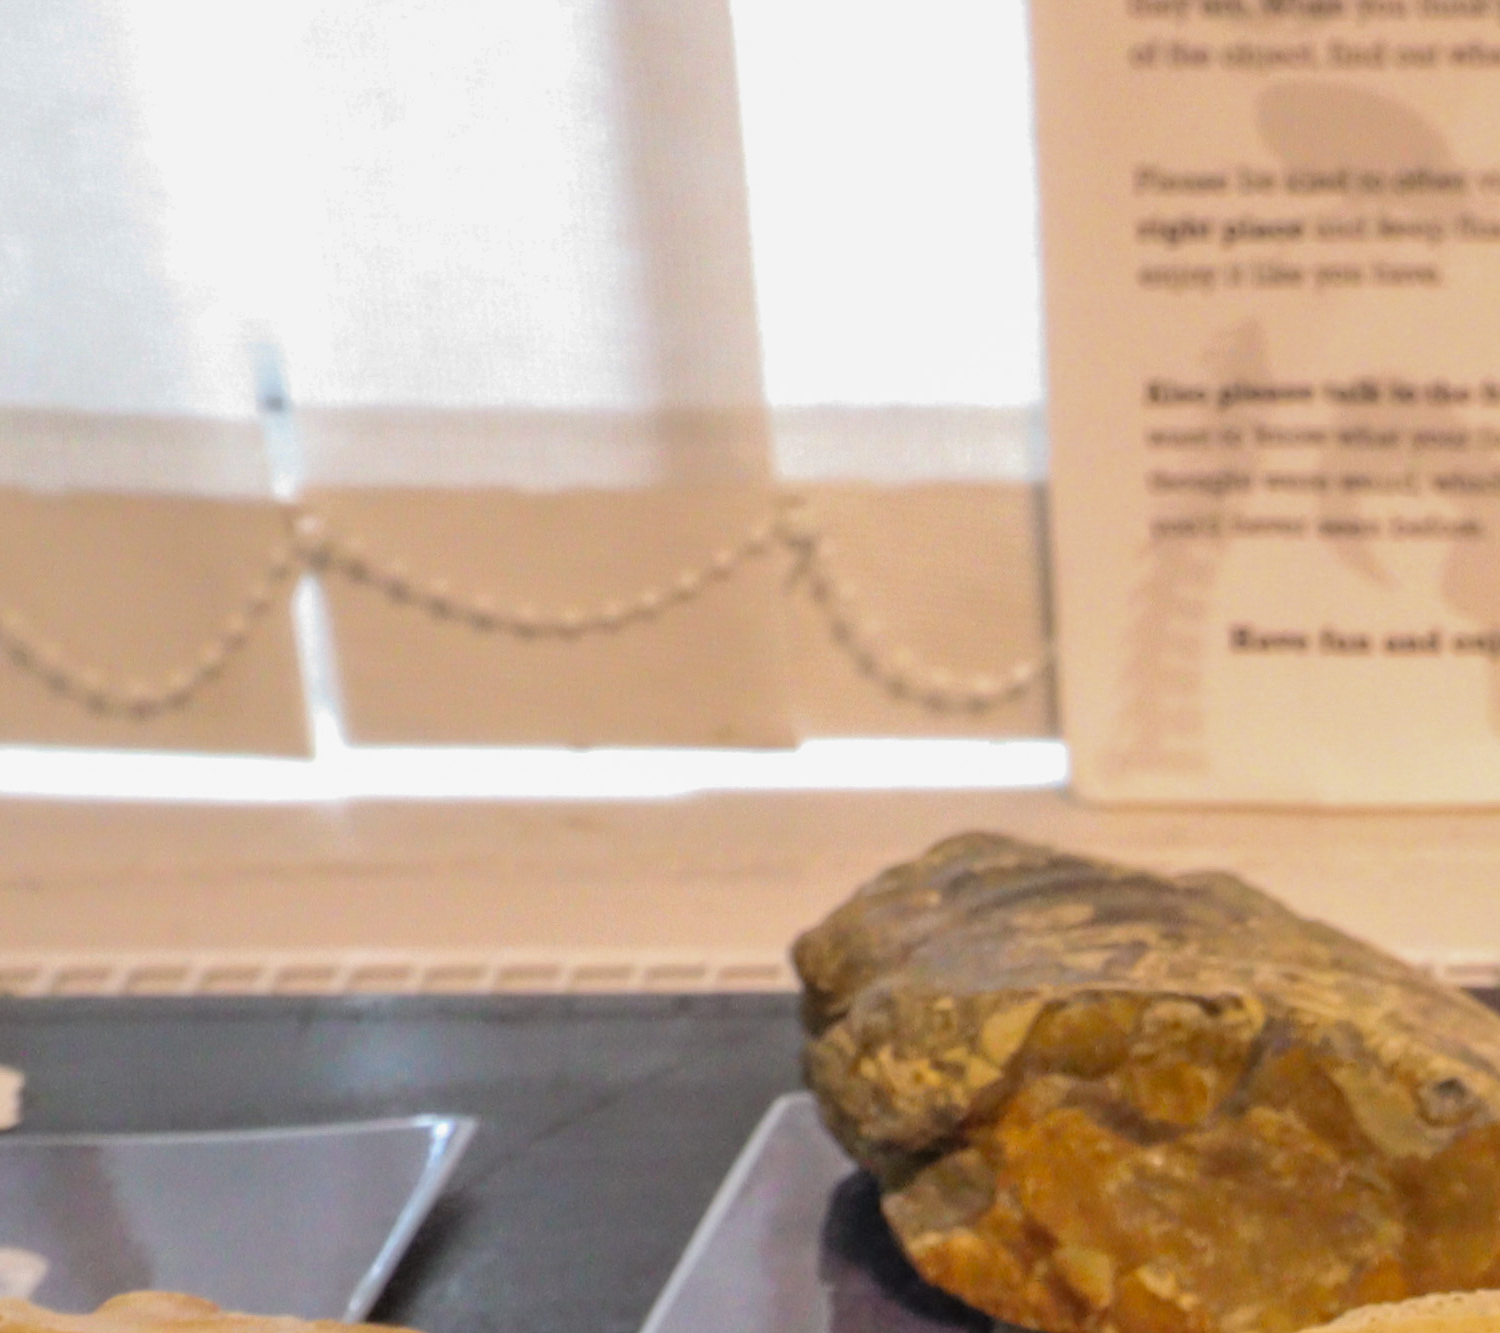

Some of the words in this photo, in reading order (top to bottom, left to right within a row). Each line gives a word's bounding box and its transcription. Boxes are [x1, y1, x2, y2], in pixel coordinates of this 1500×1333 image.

[1228, 622, 1308, 651] Have
[1317, 622, 1373, 651] fun
[1381, 622, 1443, 651] and
